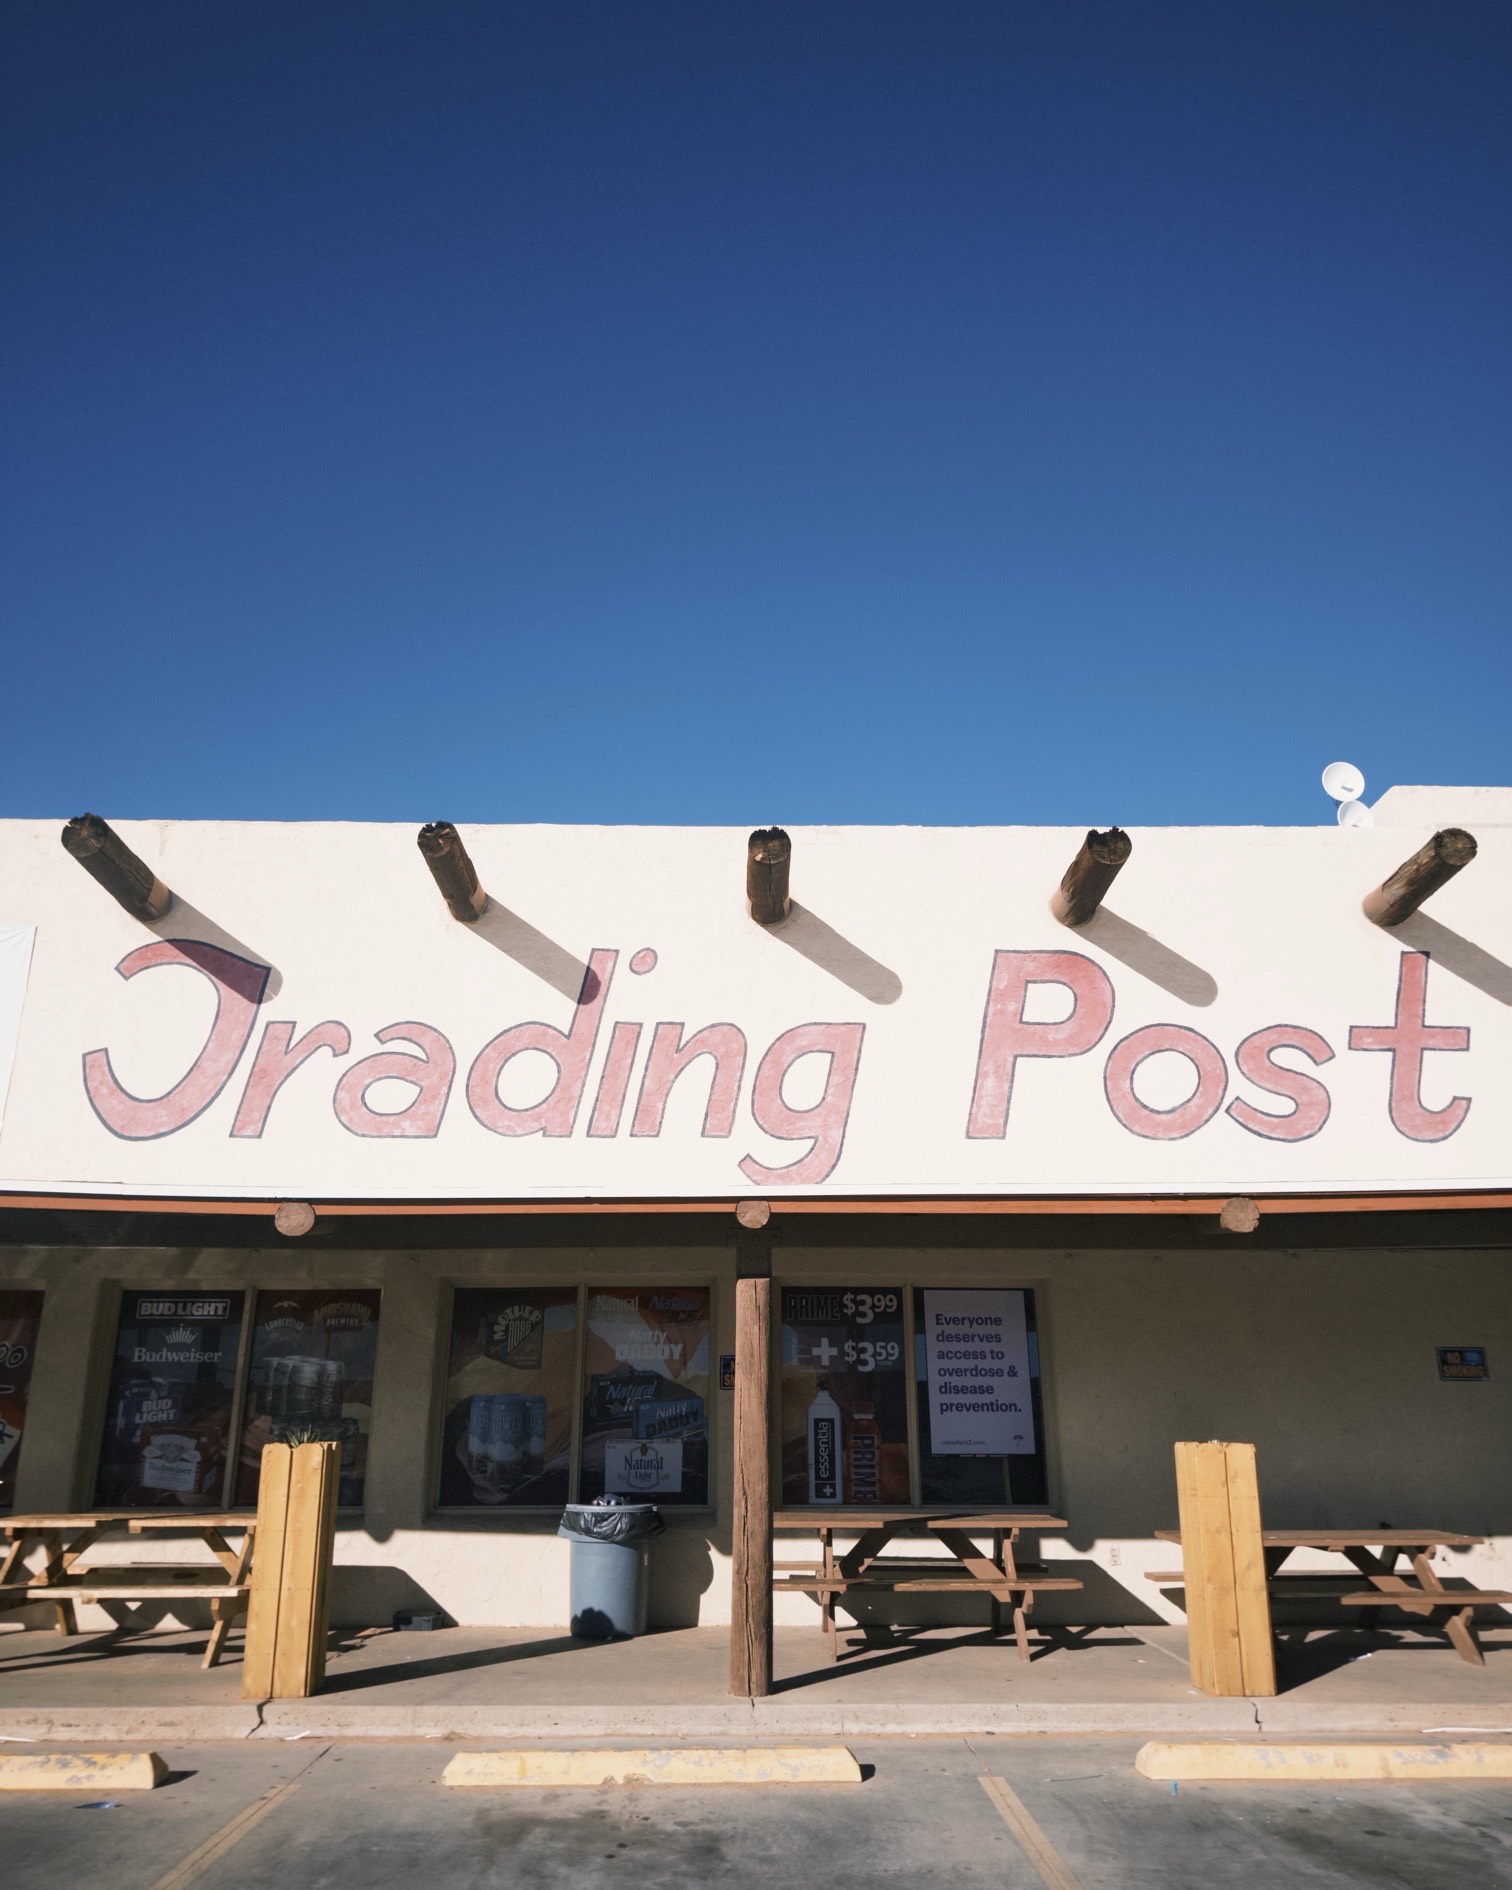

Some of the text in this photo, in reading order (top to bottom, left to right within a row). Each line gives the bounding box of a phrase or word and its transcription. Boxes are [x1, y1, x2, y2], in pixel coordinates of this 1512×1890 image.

[82, 938, 1472, 1185] Trading Post
[140, 1302, 226, 1315] BUD LIGHT
[786, 1294, 841, 1321] PRIME
[493, 1305, 541, 1341] MOTHER
[935, 1313, 1002, 1328] Everyone
[629, 1329, 667, 1344] Natty
[936, 1330, 1002, 1343] deserves
[132, 1347, 222, 1362] Budweiser
[615, 1343, 683, 1360] DADDY
[937, 1349, 1005, 1360] access to
[1447, 1351, 1461, 1364] NO
[938, 1365, 1019, 1377] overdose &
[1443, 1365, 1485, 1377] SMOKING
[605, 1380, 657, 1400] Natural
[939, 1381, 994, 1395] disease
[142, 1399, 172, 1412] BUD
[656, 1402, 688, 1419] Natty
[940, 1399, 1022, 1415] prevention.
[135, 1409, 176, 1424] LIGHT
[818, 1422, 830, 1478] essentia
[148, 1461, 193, 1475] Budweiser
[624, 1455, 664, 1471] Natural
[851, 1434, 879, 1502] PRIME
